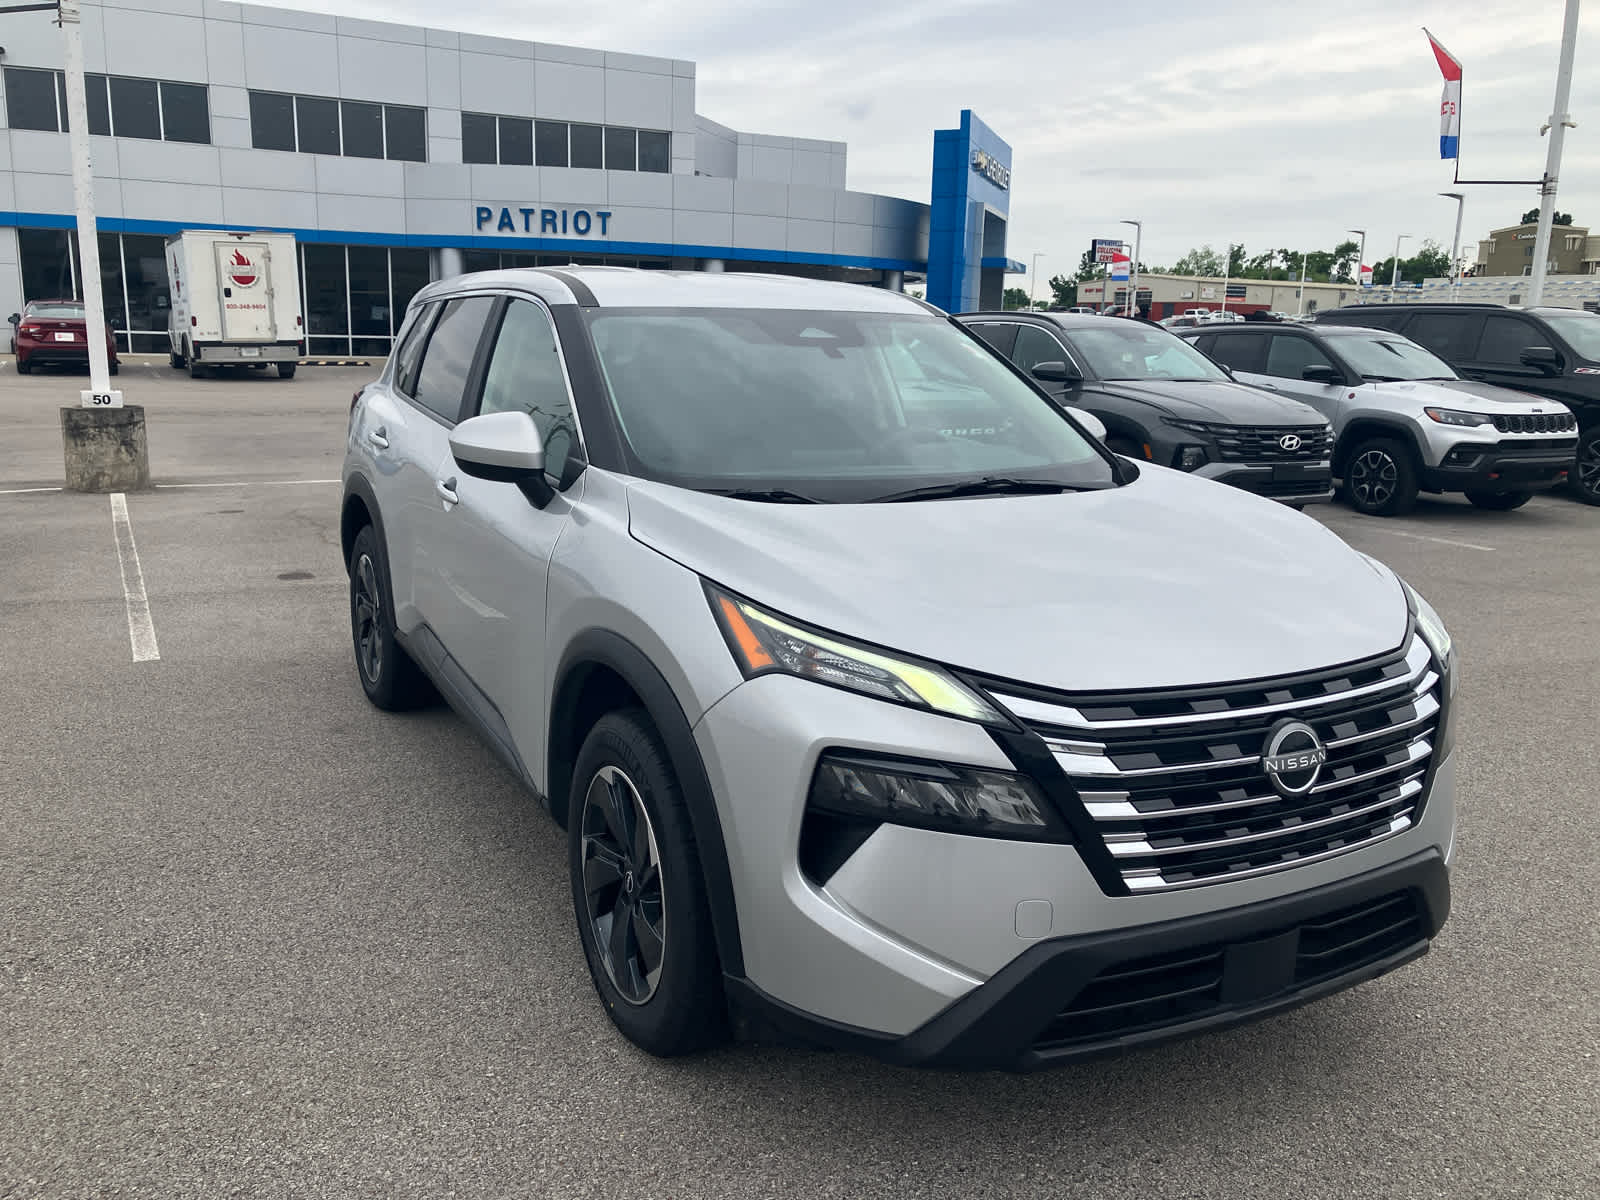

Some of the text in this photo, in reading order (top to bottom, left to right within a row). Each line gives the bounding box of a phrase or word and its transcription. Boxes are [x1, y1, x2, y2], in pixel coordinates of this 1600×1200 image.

[476, 206, 611, 235] PATRIOT
[92, 395, 111, 405] 50
[1265, 750, 1326, 772] NISSAN
